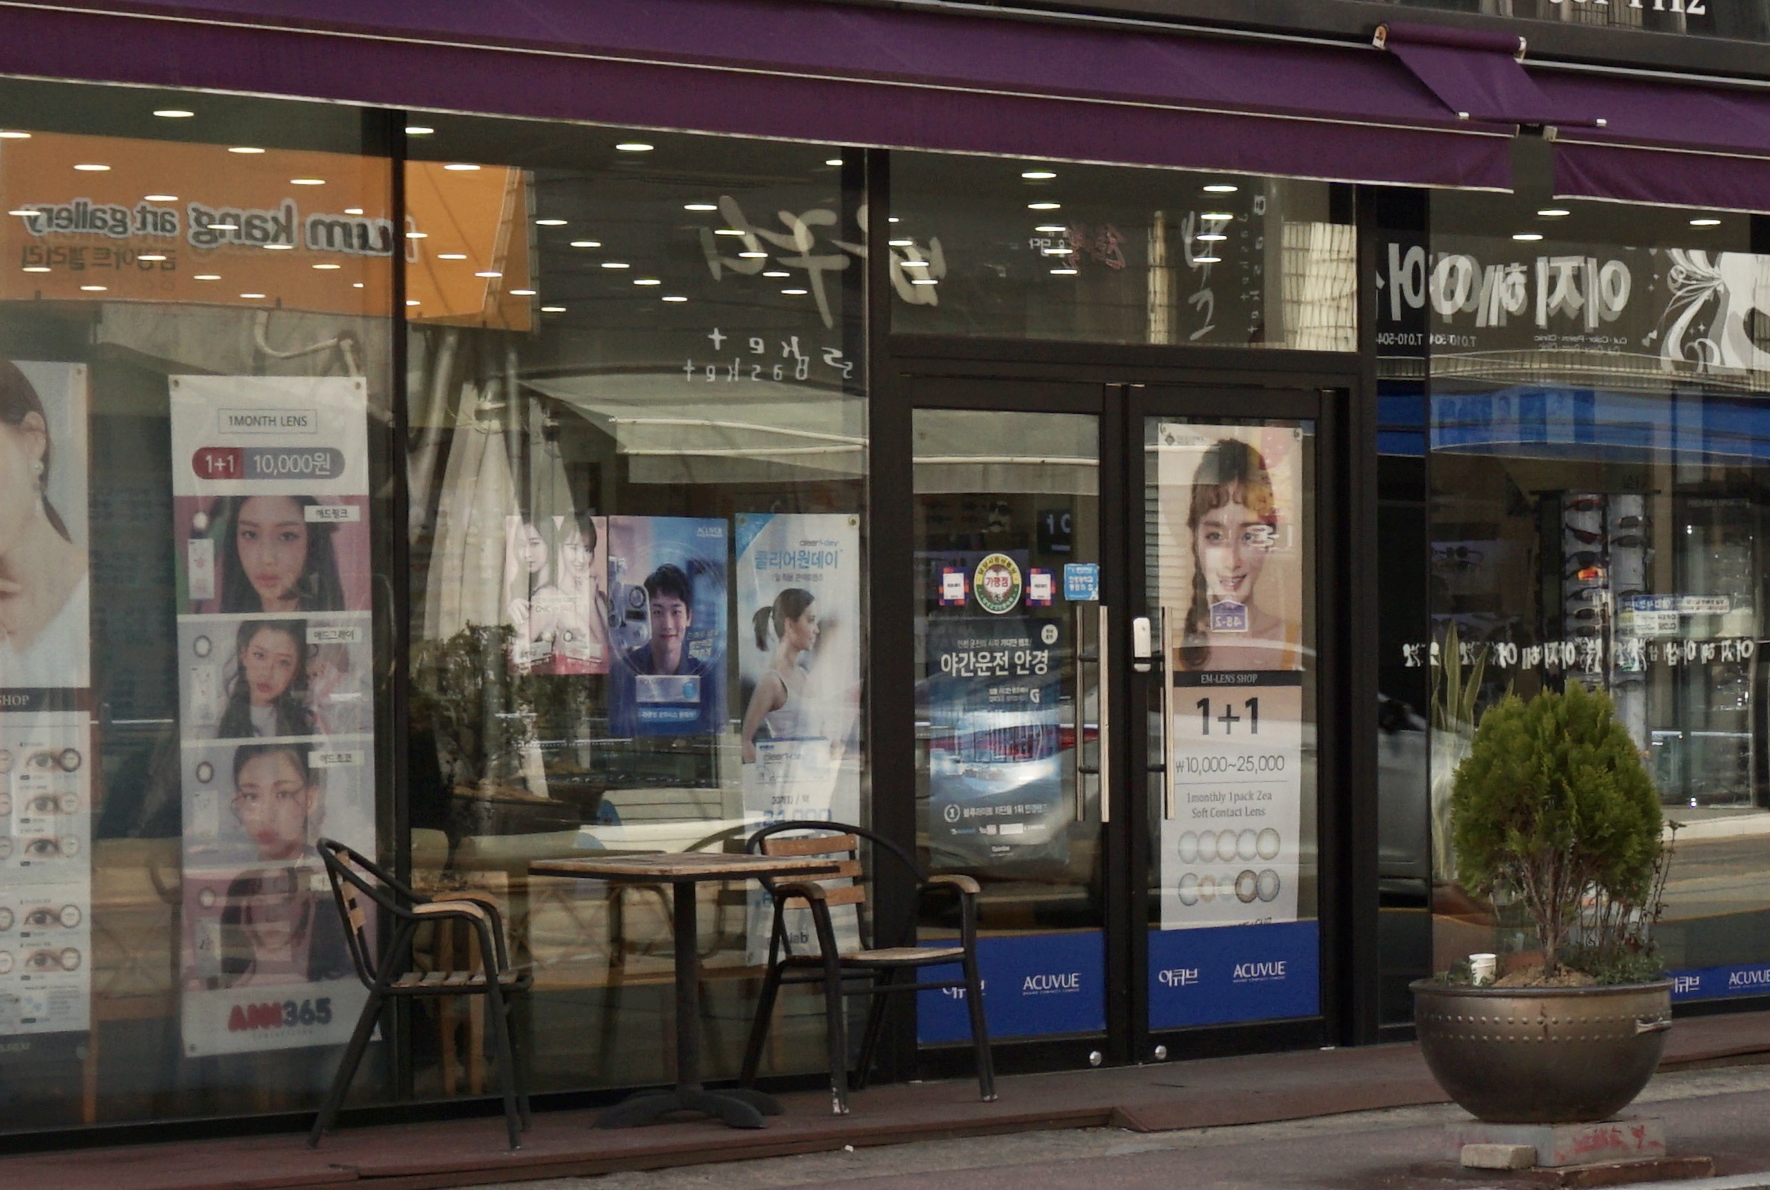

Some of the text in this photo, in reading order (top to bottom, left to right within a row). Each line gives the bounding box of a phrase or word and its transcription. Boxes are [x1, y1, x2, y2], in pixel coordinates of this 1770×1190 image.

[229, 415, 308, 427] 1MONTH LENS
[205, 452, 331, 476] 1+1 10,000원
[755, 550, 839, 570] 클리어원데이
[941, 650, 1049, 677] 야간운전 안경
[1196, 696, 1260, 736] 1+1
[1233, 961, 1288, 979] ACUVUE
[1022, 972, 1082, 991] ACUVUE
